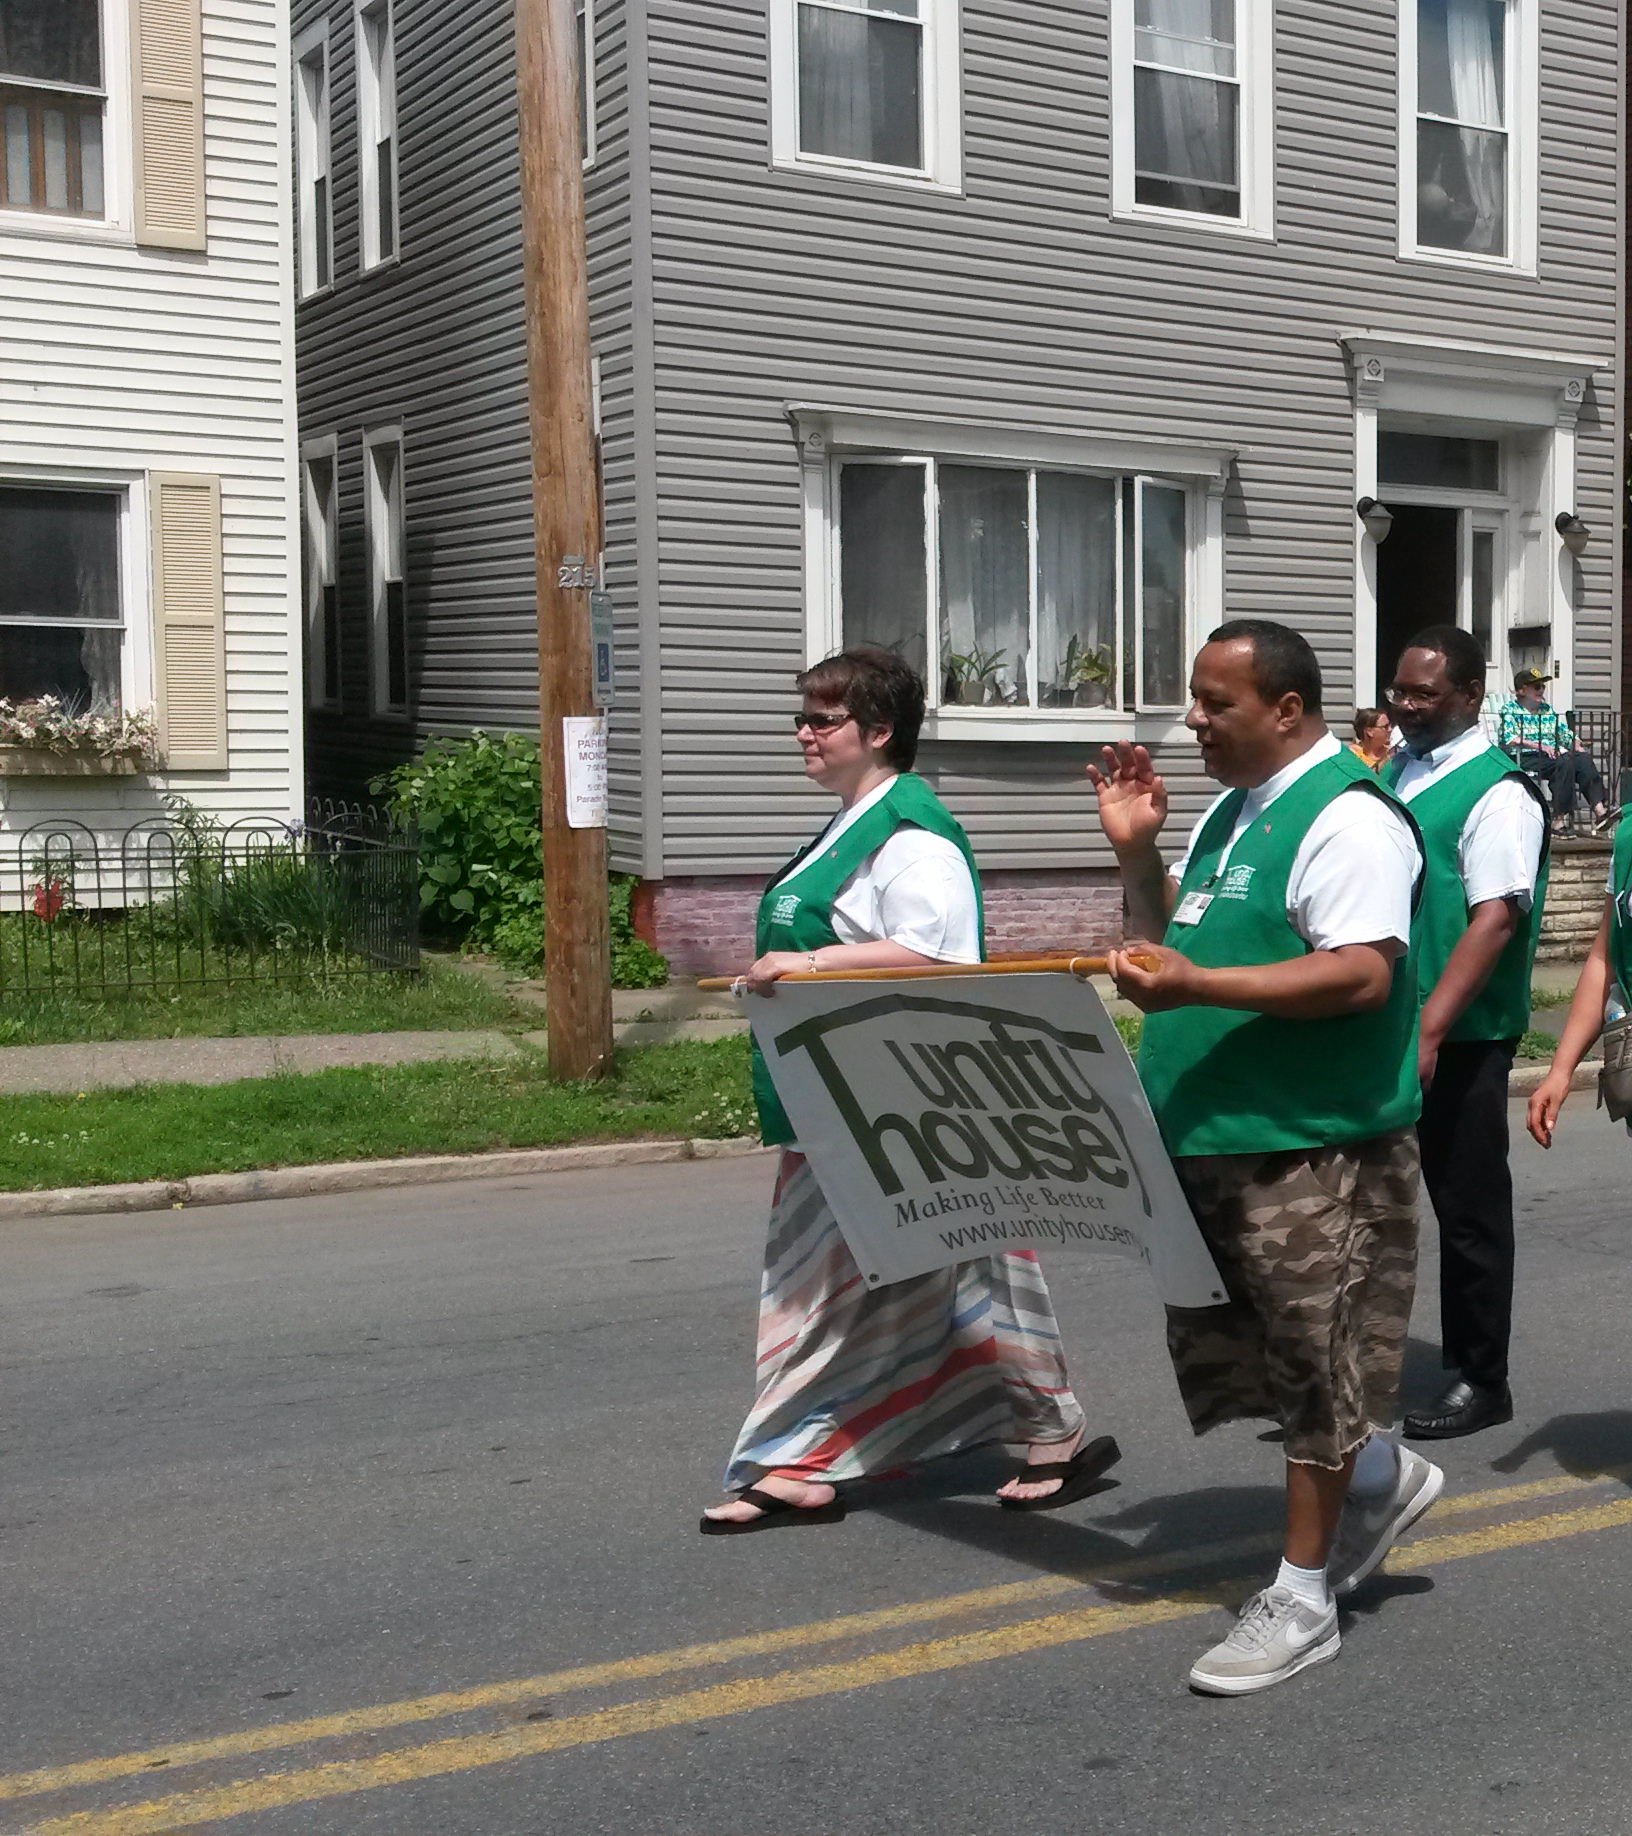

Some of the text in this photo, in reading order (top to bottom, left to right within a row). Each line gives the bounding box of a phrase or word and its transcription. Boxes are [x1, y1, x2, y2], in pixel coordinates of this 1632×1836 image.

[558, 566, 595, 588] 215
[883, 1022, 1108, 1112] unity
[818, 1072, 1131, 1197] house
[893, 1186, 1106, 1229] Making Life Better
